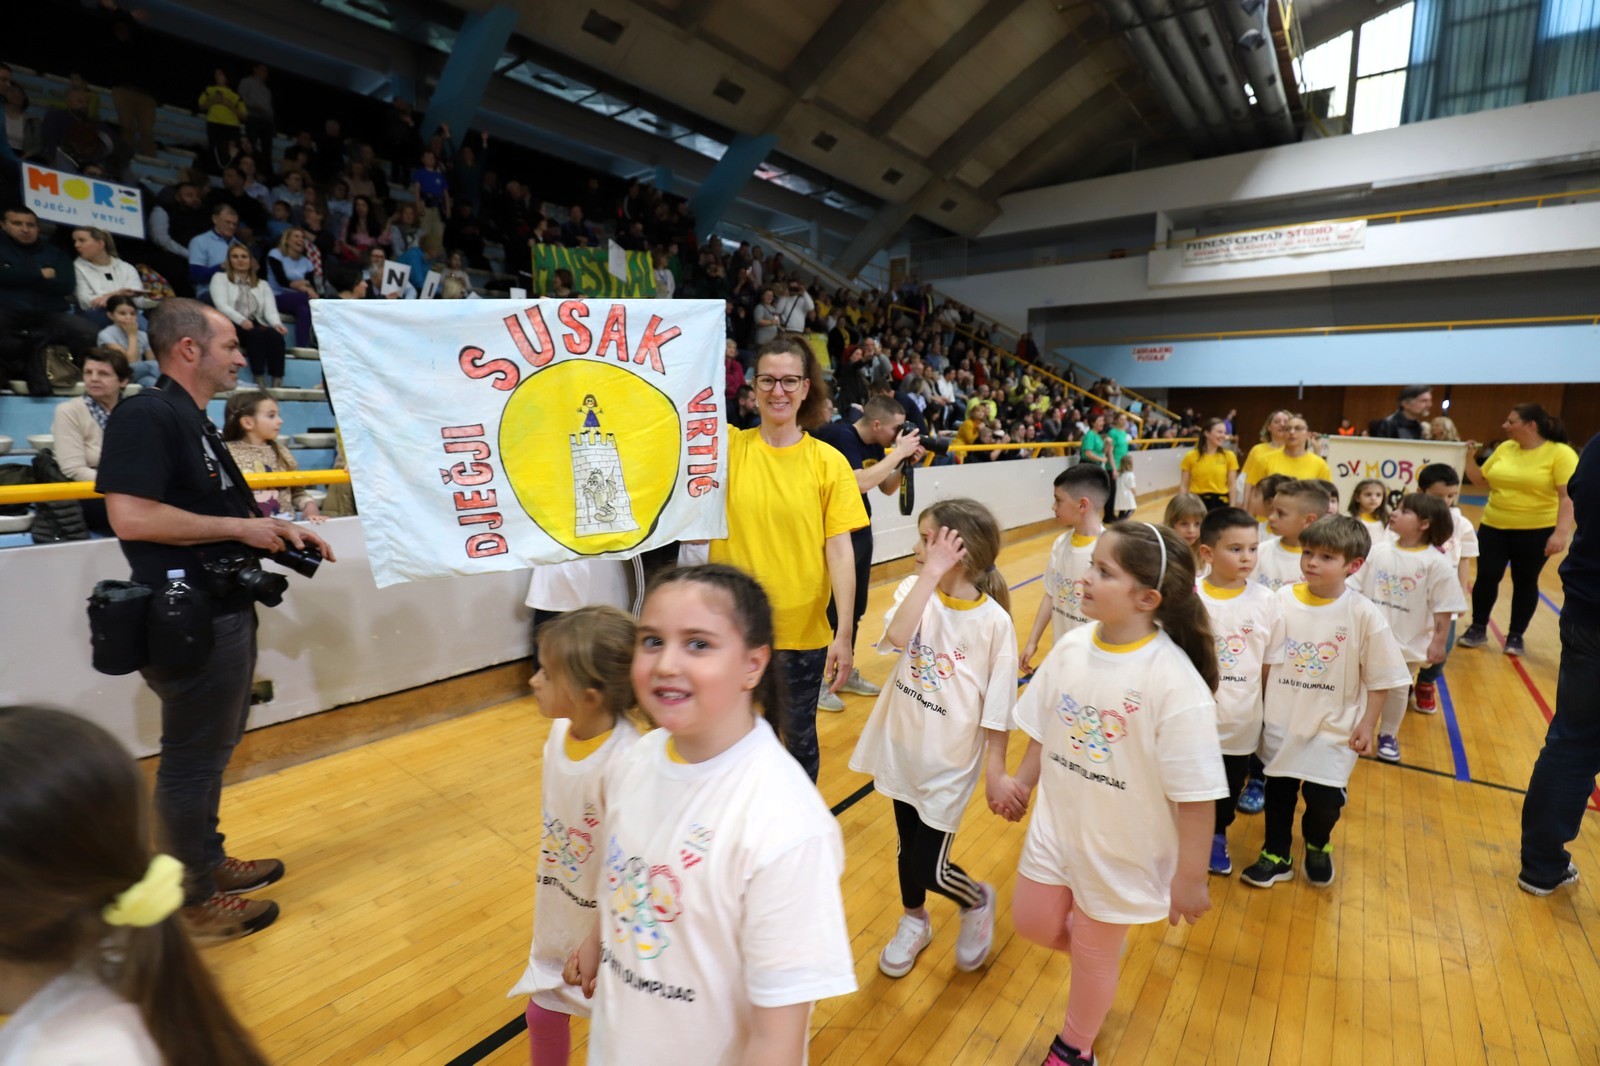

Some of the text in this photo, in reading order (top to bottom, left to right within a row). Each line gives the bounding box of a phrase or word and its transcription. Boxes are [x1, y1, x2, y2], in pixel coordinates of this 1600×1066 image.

[34, 199, 125, 225] DJEČJI VRTIĆ
[1286, 226, 1333, 238] STUDIO
[387, 268, 406, 288] N
[687, 386, 719, 498] VRTIĆ
[438, 423, 509, 559] DJEČJI
[1219, 675, 1248, 683] LIMPIJAC
[1302, 682, 1336, 692] OLIMPIJAC
[903, 686, 918, 699] BITI
